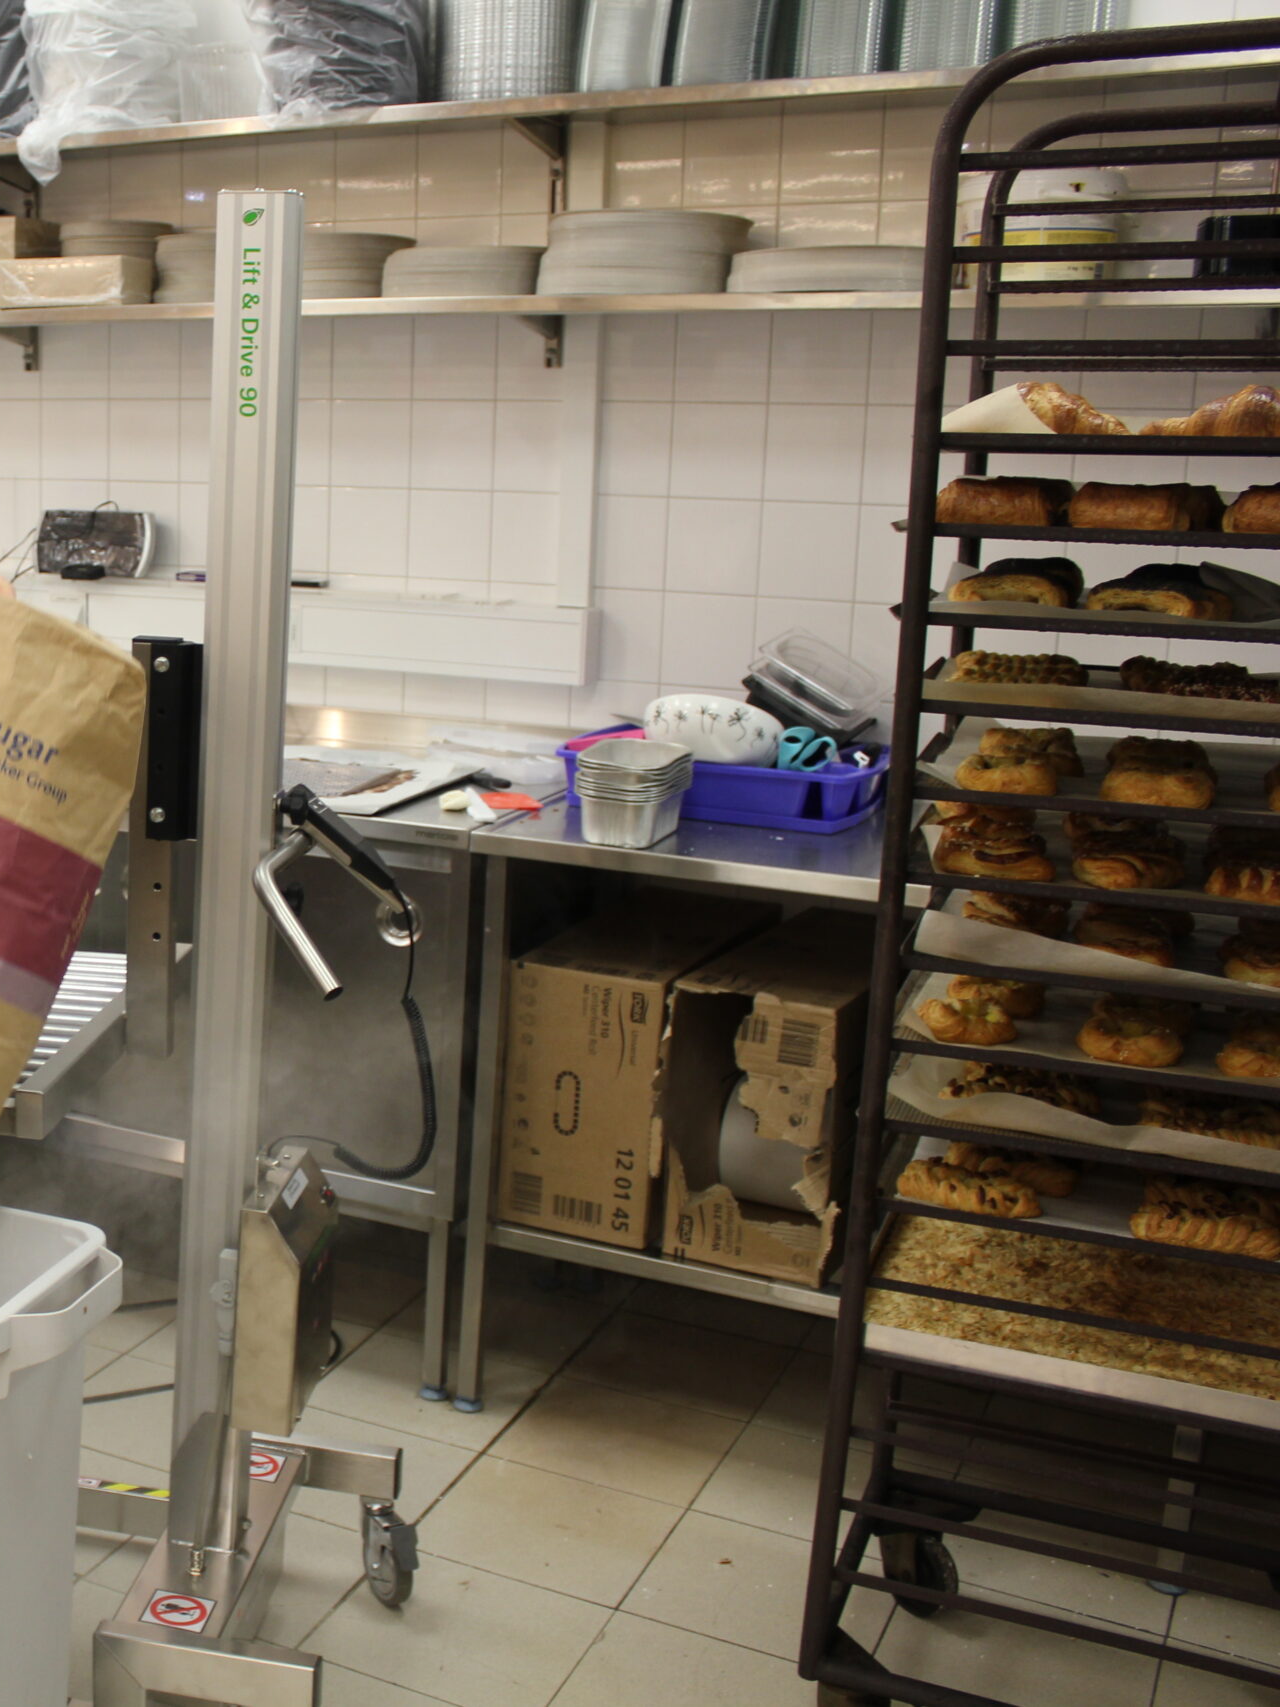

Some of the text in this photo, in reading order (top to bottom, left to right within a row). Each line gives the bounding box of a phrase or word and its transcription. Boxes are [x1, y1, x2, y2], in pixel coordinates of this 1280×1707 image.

[239, 248, 262, 418] Lift & Drive 90
[26, 771, 68, 806] Group
[600, 987, 613, 1039] Wiper 310
[611, 1148, 635, 1233] 12 01 45
